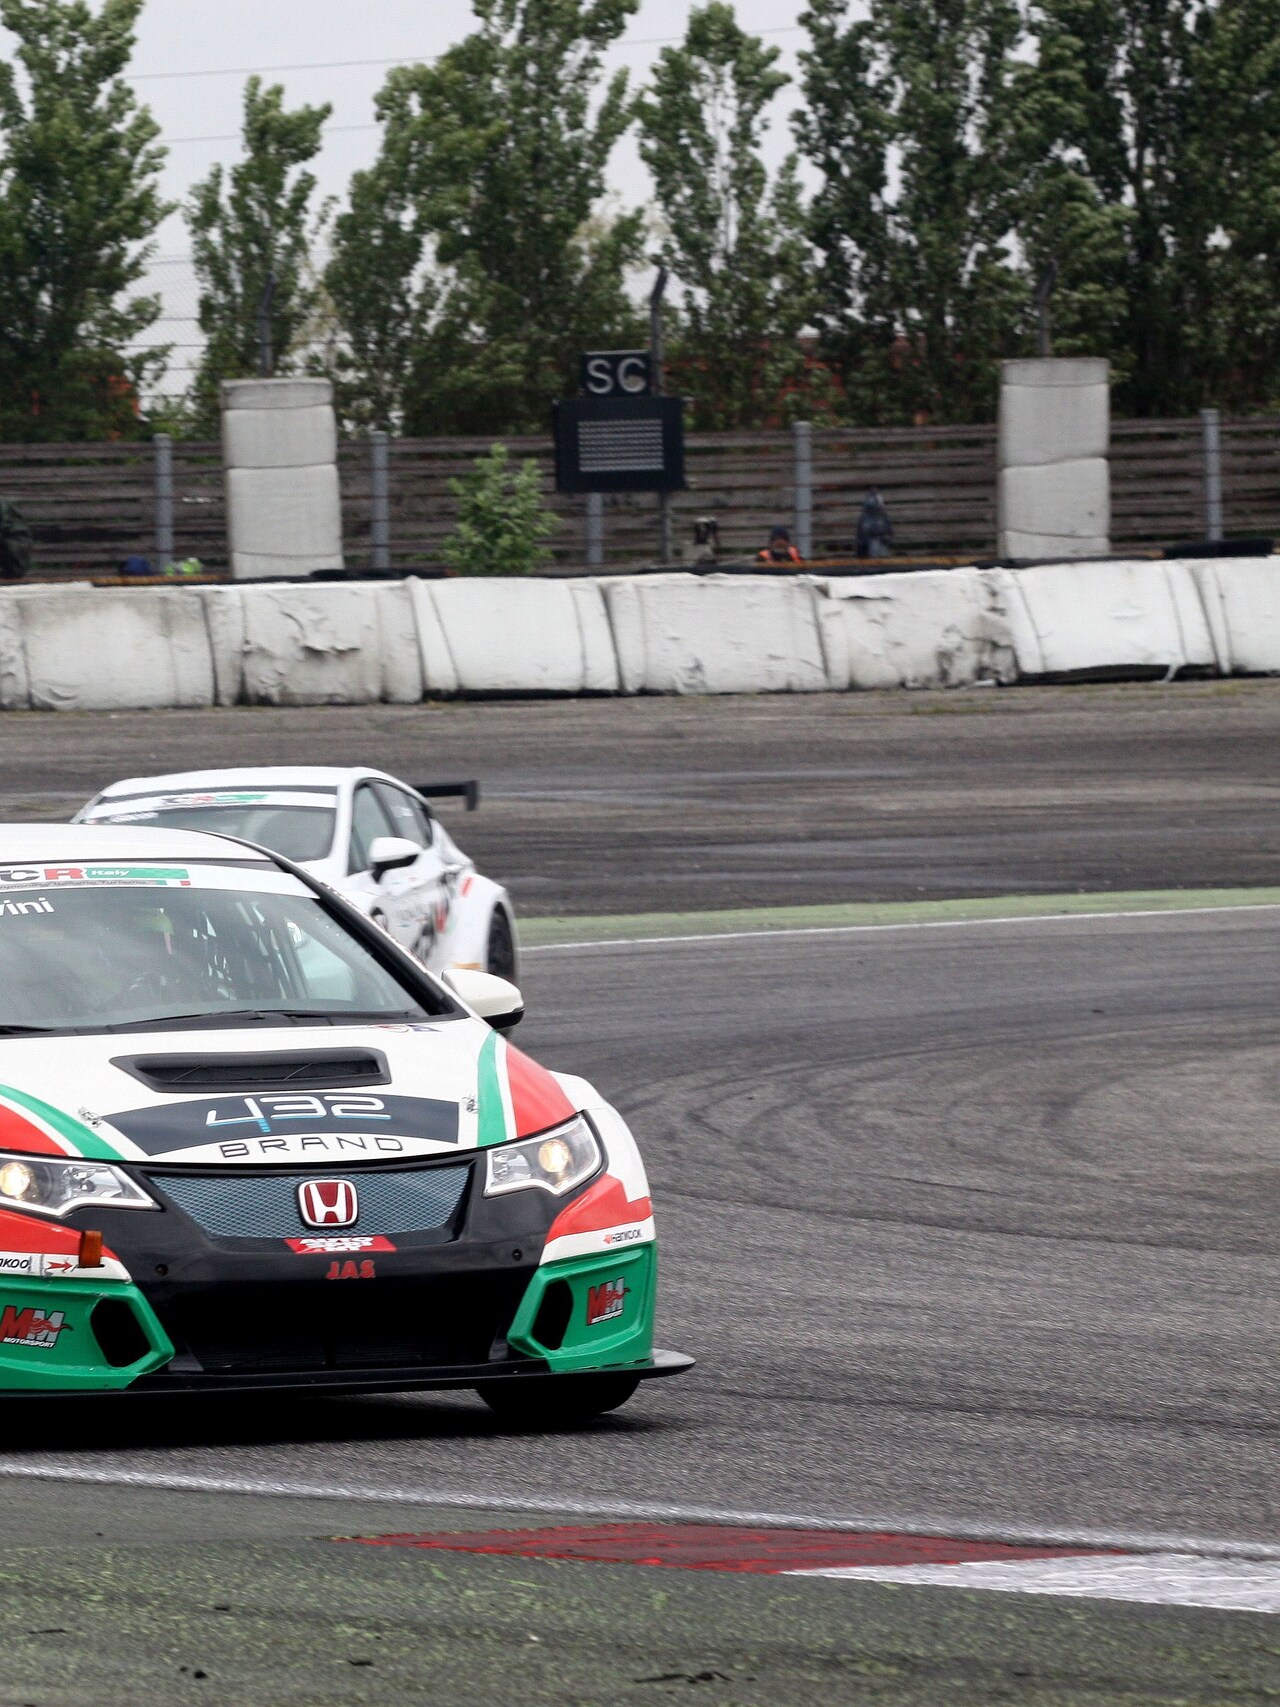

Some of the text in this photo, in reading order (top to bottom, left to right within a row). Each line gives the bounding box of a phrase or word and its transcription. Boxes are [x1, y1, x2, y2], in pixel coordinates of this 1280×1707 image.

[586, 357, 647, 394] SC
[91, 869, 130, 878] Italy
[205, 1095, 392, 1133] 432
[218, 1136, 404, 1159] BRAND
[3, 1336, 56, 1349] MOTORSPORT
